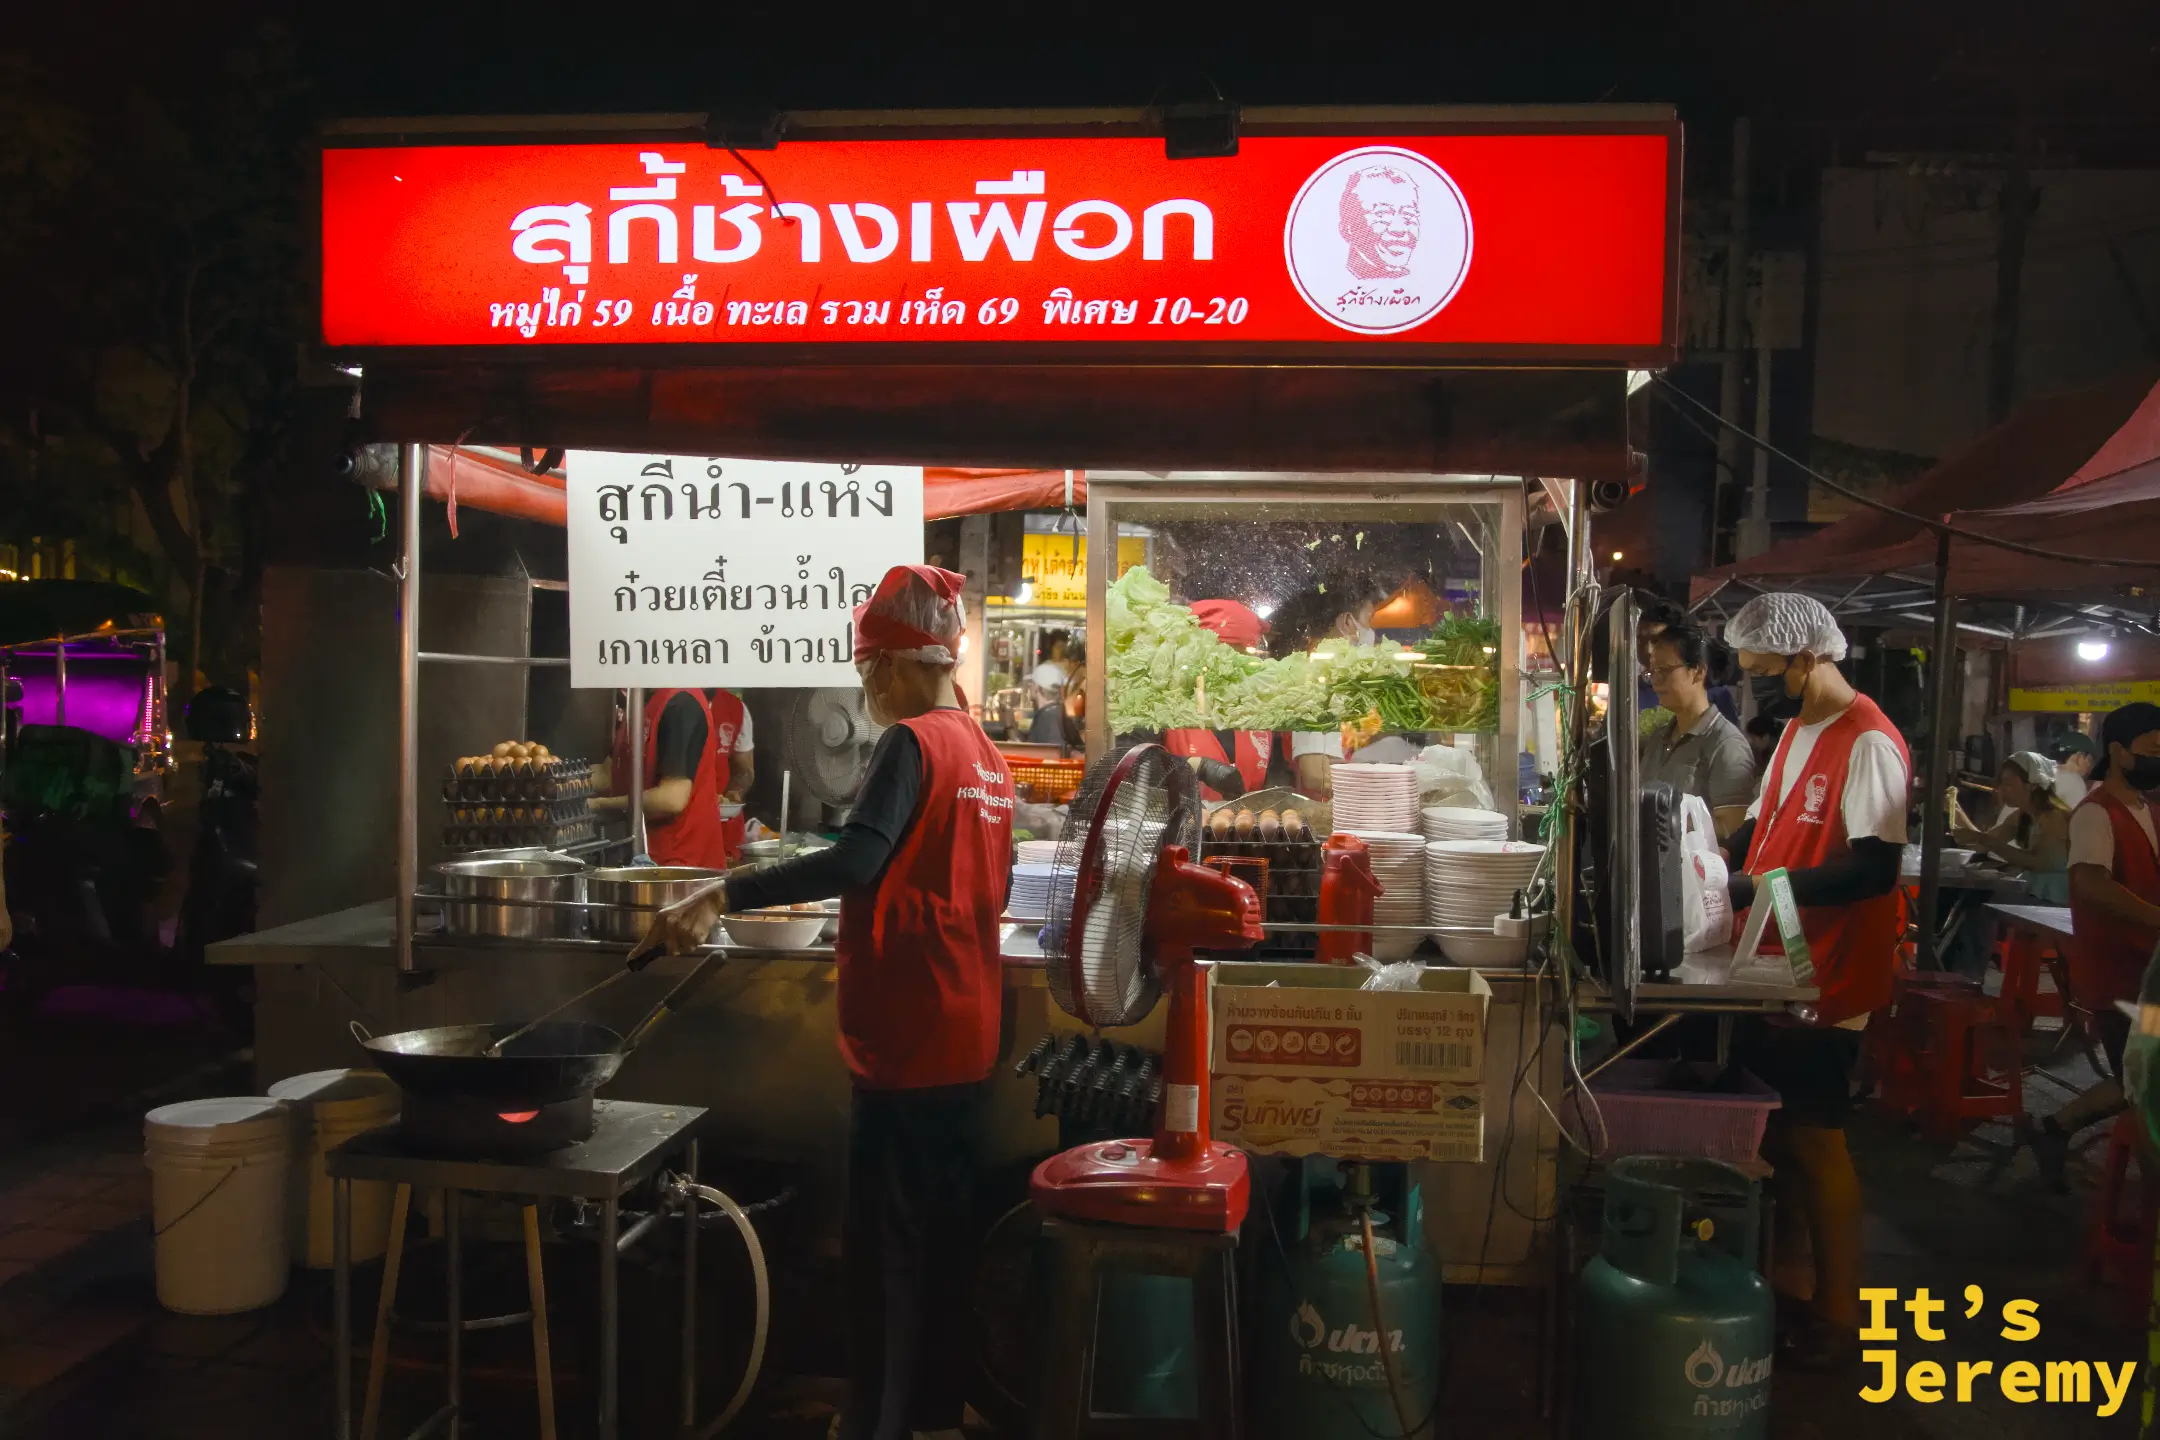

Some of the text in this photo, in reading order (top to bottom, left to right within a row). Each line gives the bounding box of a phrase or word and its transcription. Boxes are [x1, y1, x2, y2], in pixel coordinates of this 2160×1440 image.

[510, 153, 1214, 284] สุกี้ช้างเผือก
[490, 274, 1249, 338] หมูไก่ 59 เนื้อ ทะเล รวม เห็ด 69 พิเศษ 10-20
[599, 638, 730, 665] เกาเหลา
[1335, 1009, 1342, 1020] 8
[1436, 1026, 1451, 1037] 12
